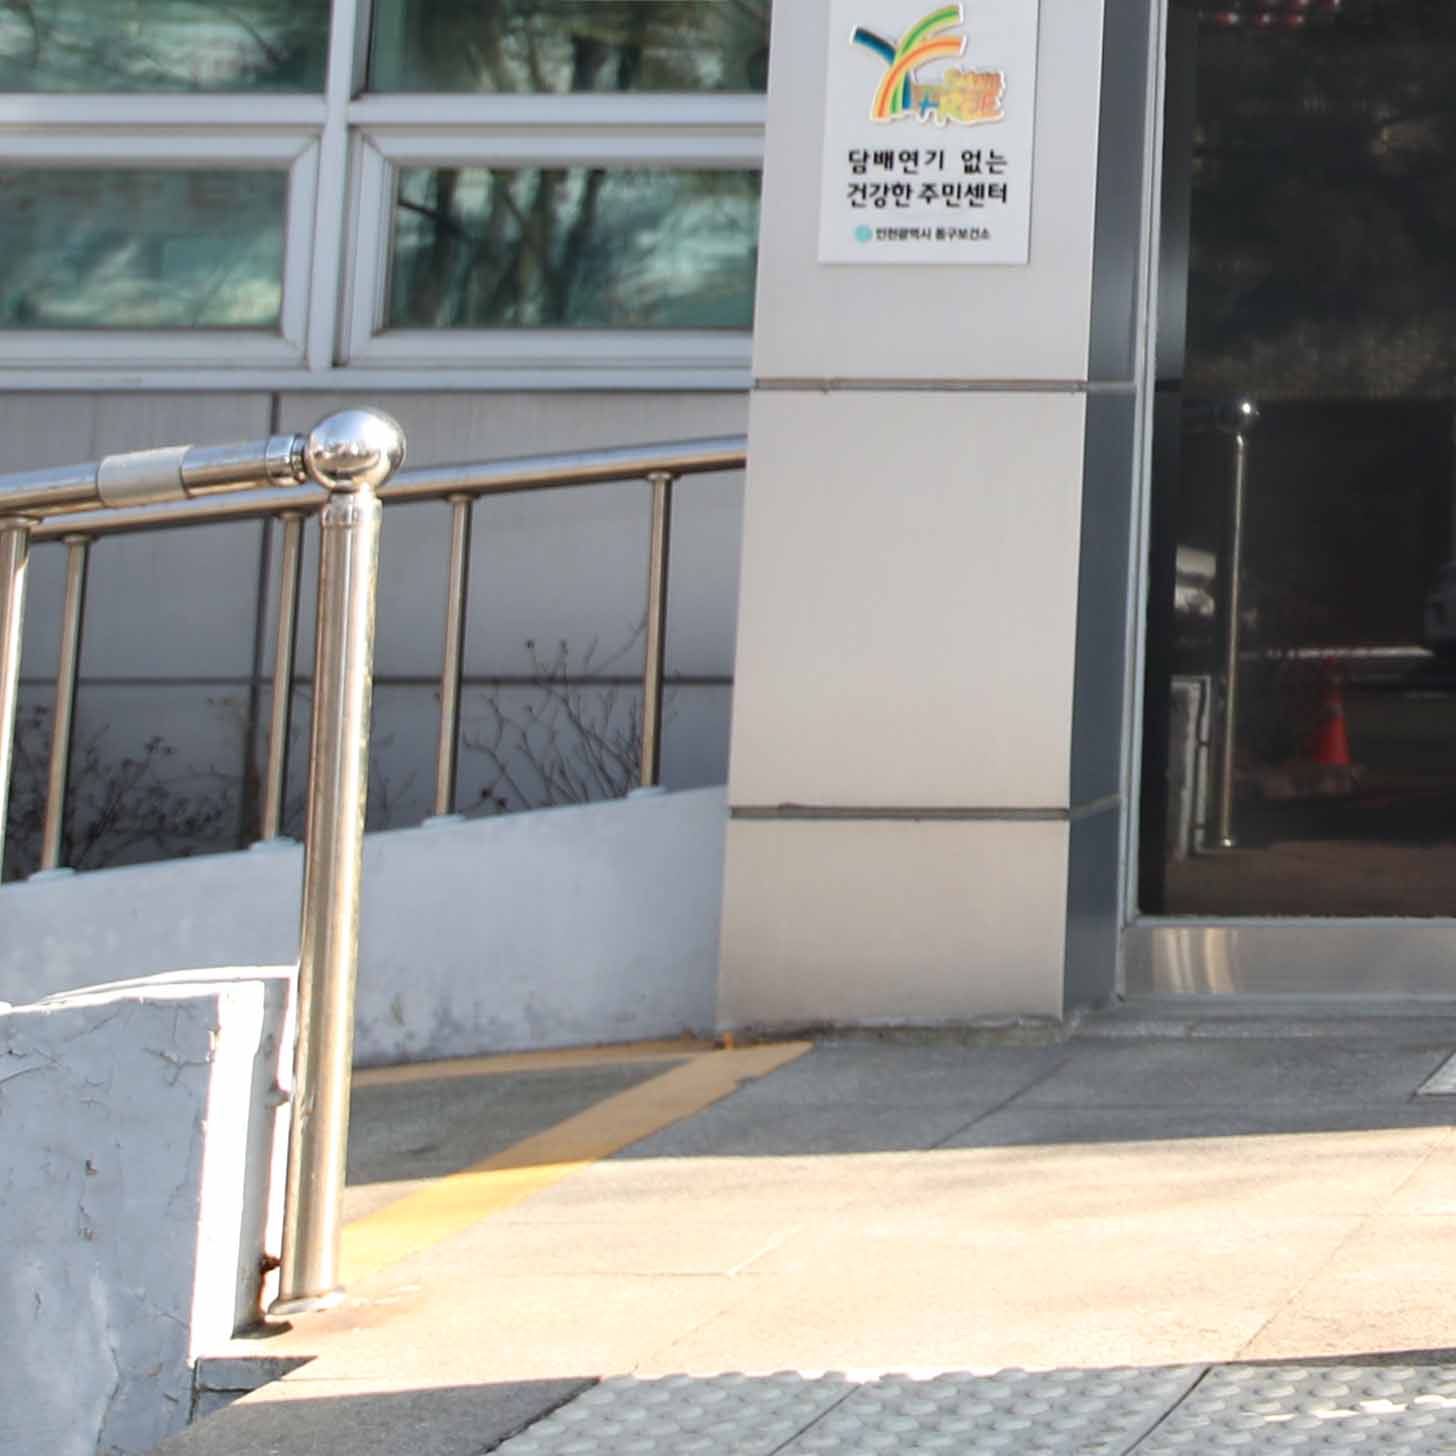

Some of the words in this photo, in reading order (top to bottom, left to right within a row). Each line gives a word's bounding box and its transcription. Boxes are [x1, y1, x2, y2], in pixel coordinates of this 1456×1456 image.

[848, 149, 944, 175] 담배연기
[961, 149, 1007, 175] 없는
[847, 182, 913, 208] 건강한
[919, 182, 1008, 206] 주민센터
